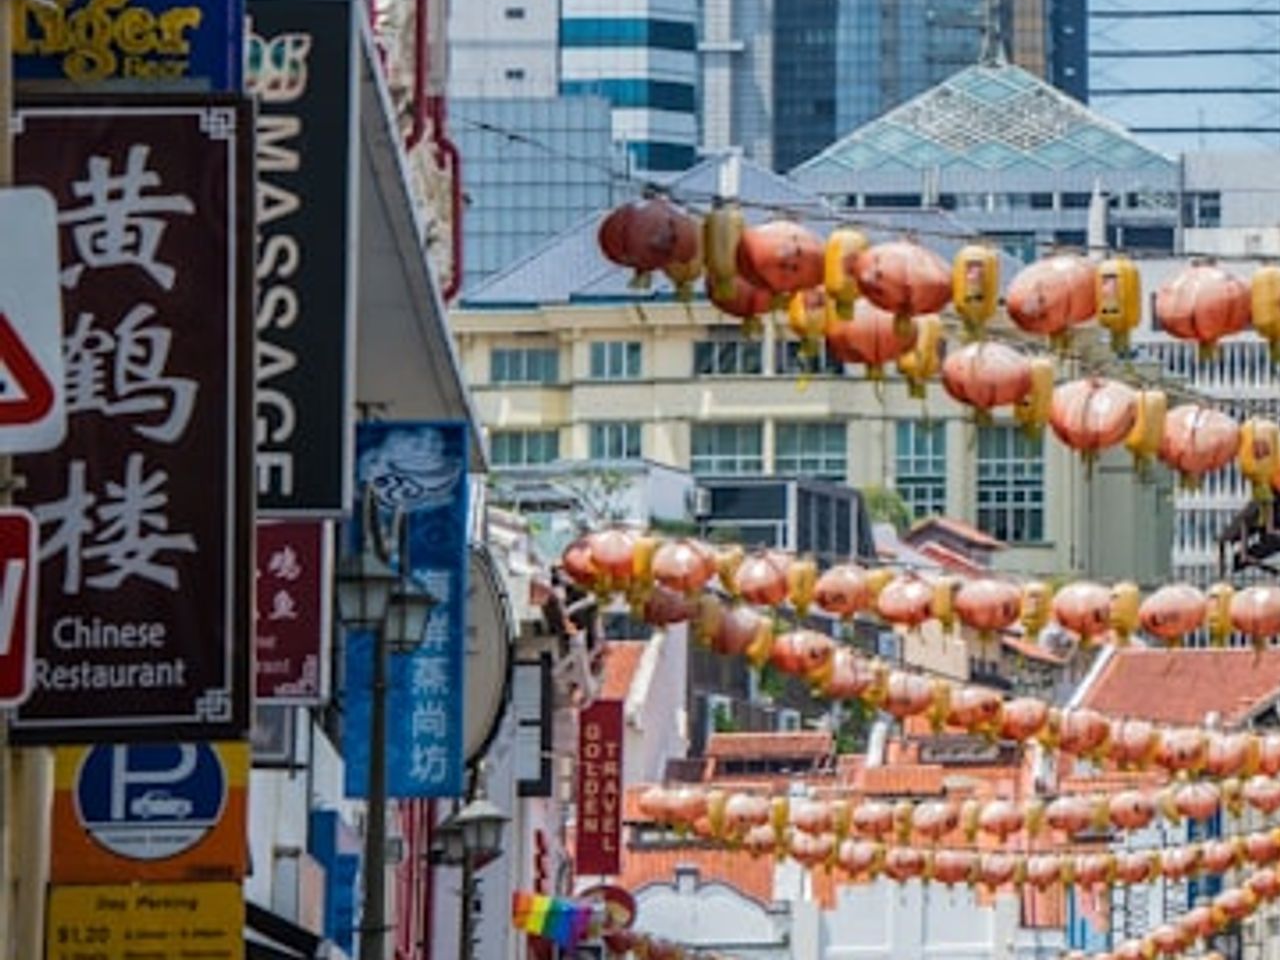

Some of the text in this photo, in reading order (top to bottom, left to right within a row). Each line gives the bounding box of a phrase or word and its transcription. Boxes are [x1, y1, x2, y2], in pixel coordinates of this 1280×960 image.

[256, 115, 303, 496] MASSAGE
[32, 143, 200, 595] 黄鹤楼
[33, 657, 188, 689] Restaurant
[53, 617, 166, 649] Chinese
[603, 742, 618, 852] TRAVEL
